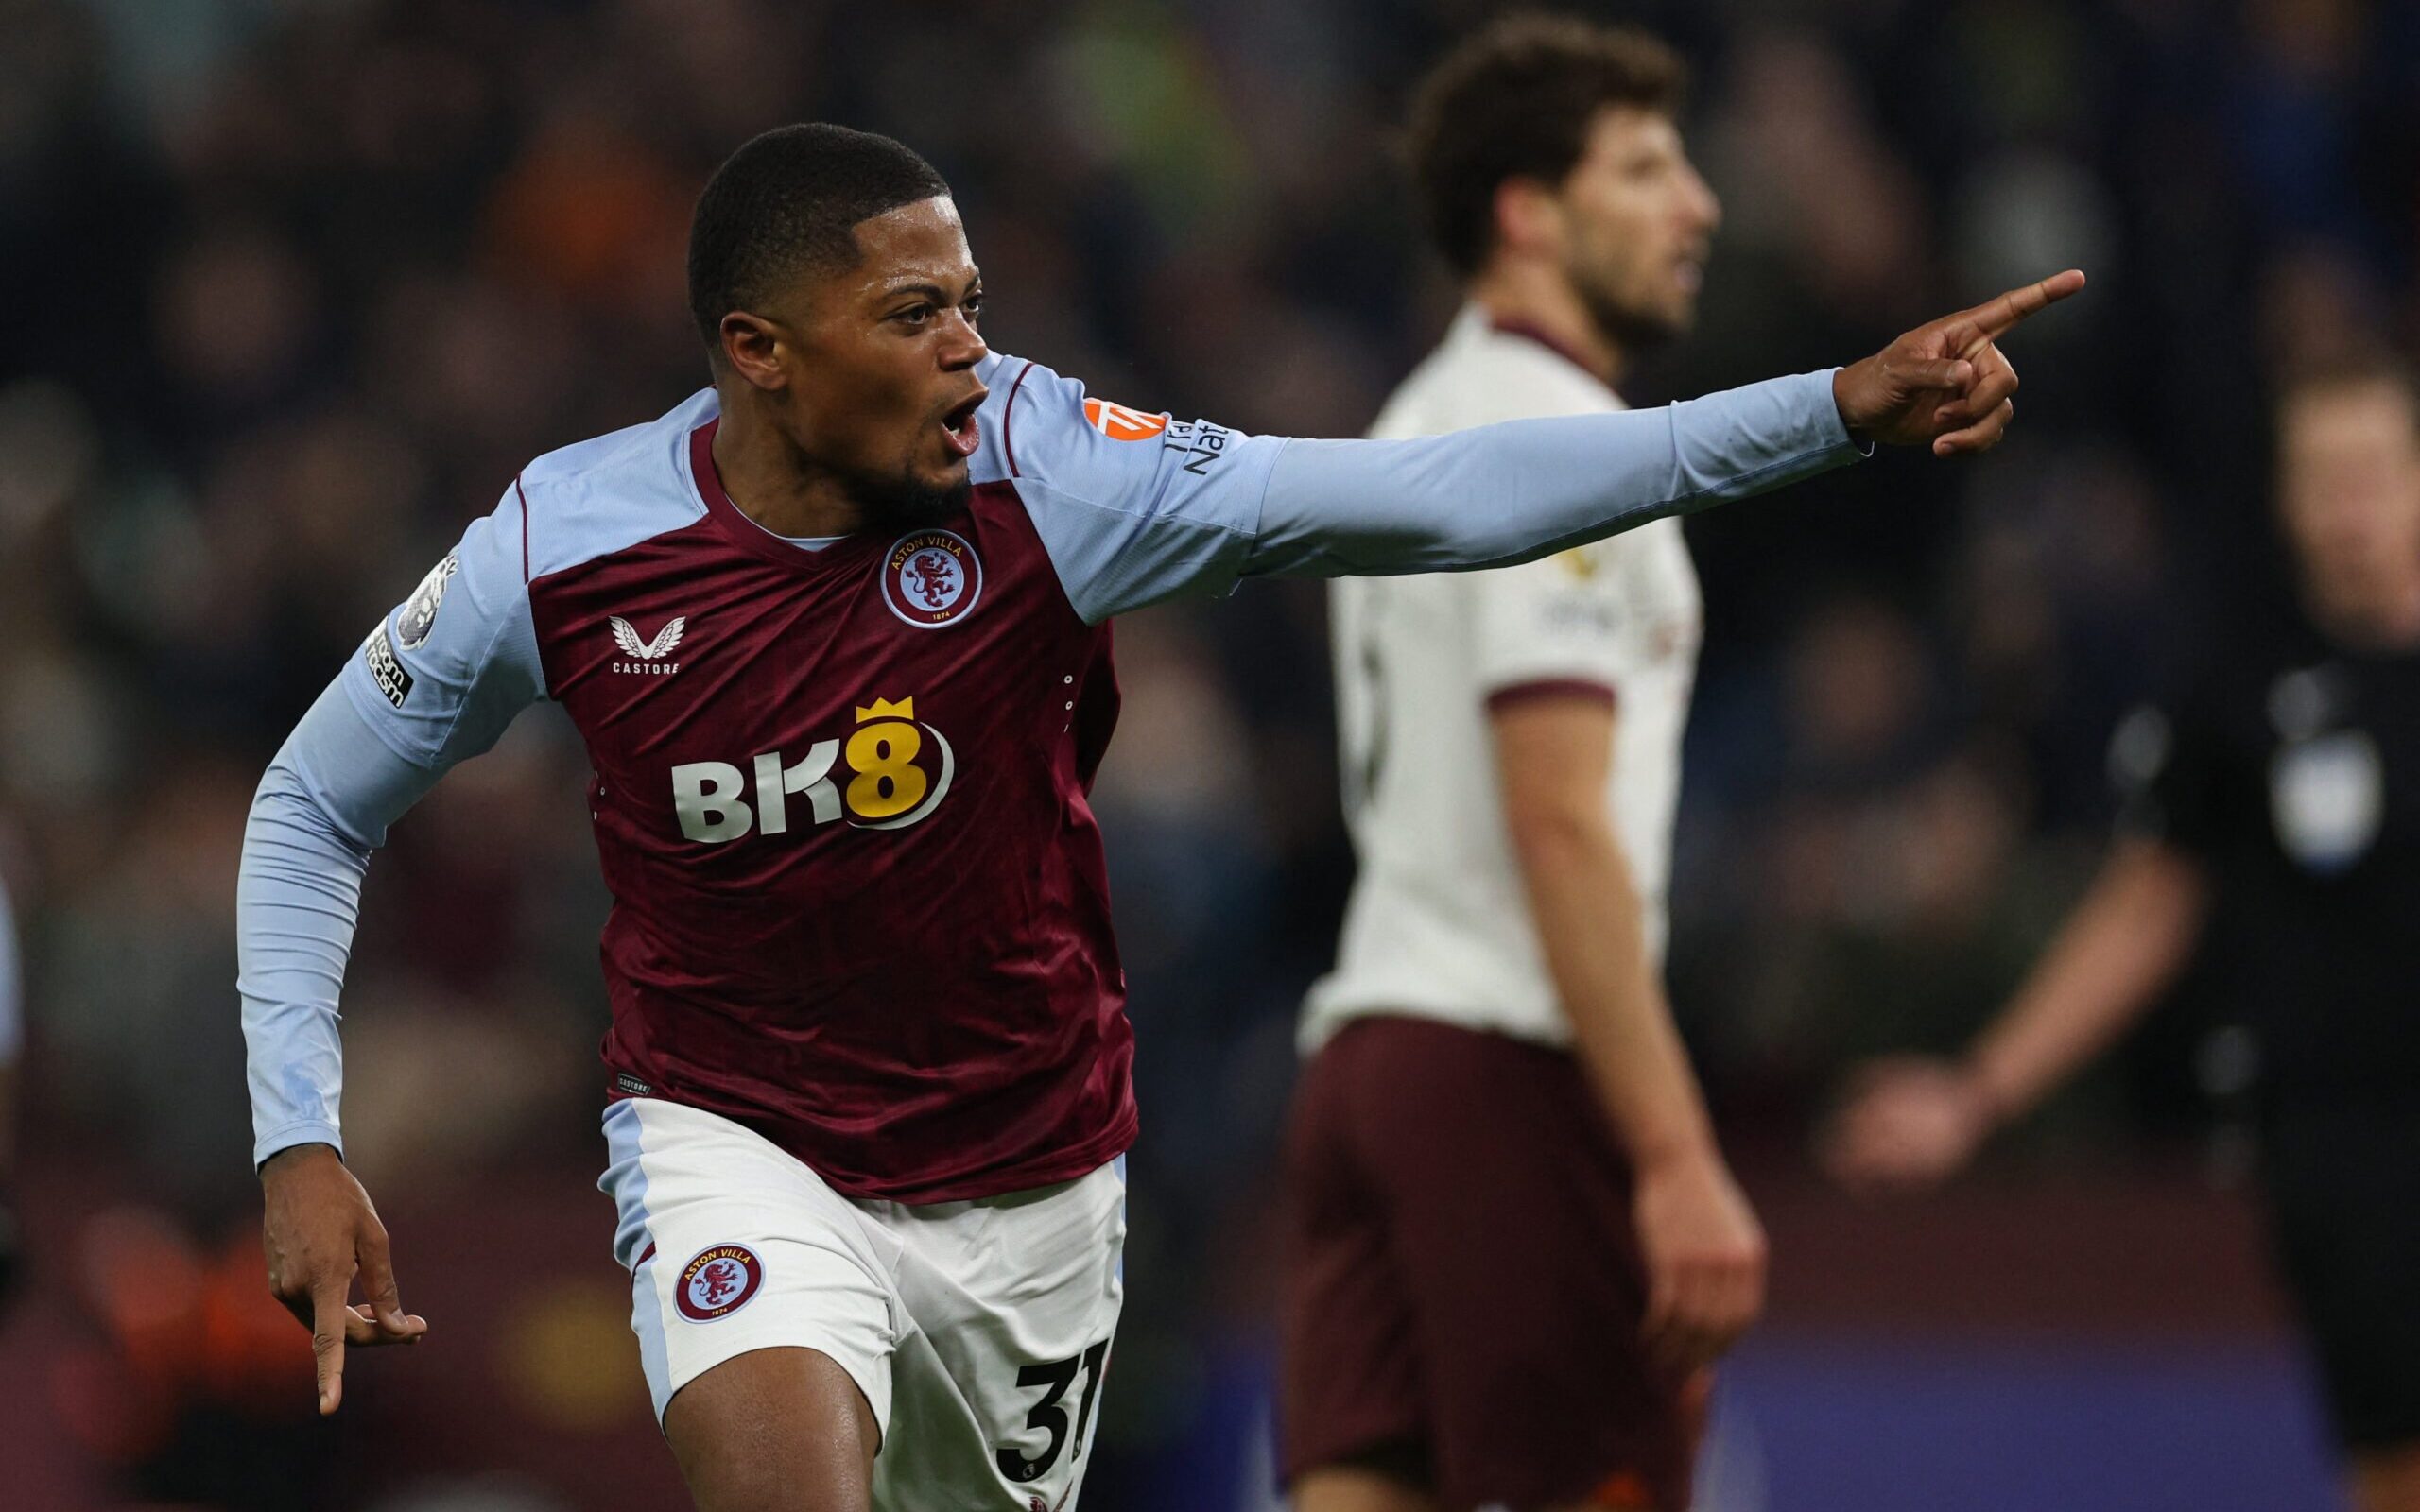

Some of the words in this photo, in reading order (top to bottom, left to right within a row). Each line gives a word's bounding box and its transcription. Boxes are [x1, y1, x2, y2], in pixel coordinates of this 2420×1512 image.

[891, 538, 924, 571] ASTON
[927, 536, 962, 558] VILLA
[932, 611, 951, 621] 1874
[366, 644, 405, 708] racism
[376, 630, 405, 687] room
[613, 662, 680, 675] CASTORE
[671, 721, 928, 844] BK8
[684, 1250, 717, 1280] ASTON
[720, 1248, 752, 1264] VILLA
[995, 1337, 1110, 1483] 31
